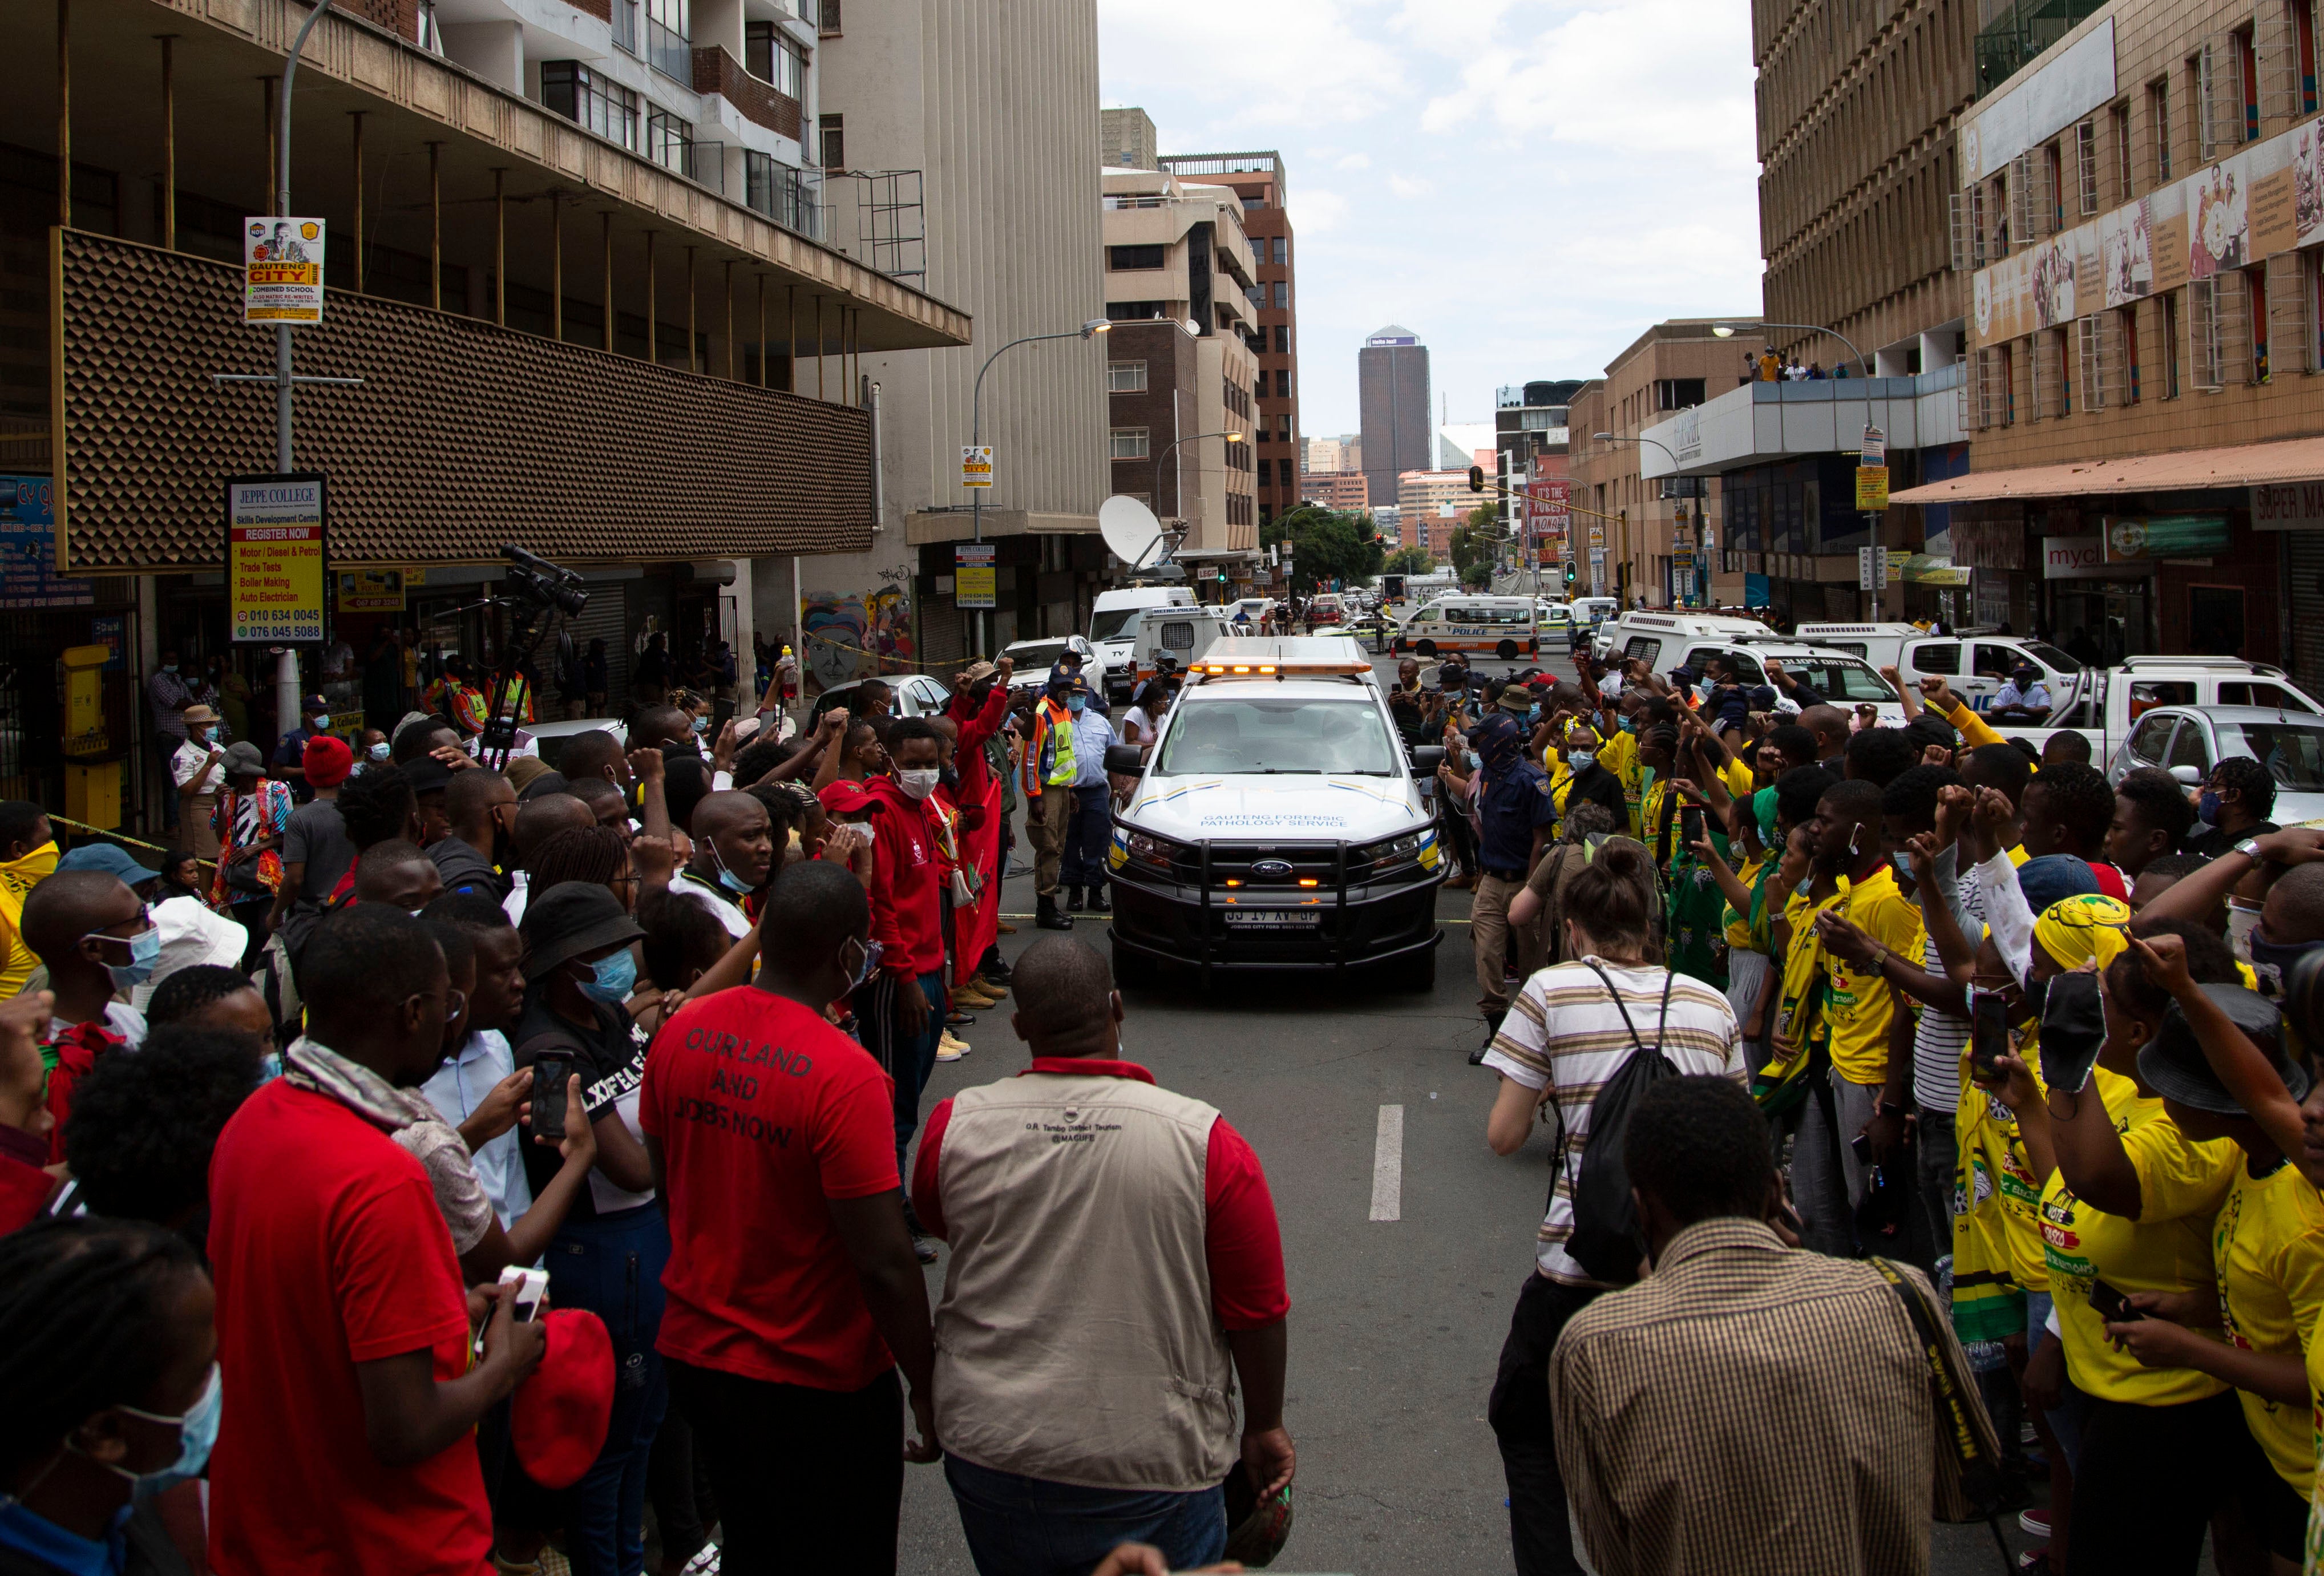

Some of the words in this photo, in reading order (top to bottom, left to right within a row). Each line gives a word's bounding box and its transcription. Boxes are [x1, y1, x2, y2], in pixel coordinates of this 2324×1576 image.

[250, 271, 306, 281] CITY
[240, 489, 268, 503] JEPPE
[269, 487, 315, 502] COLLEGE
[1537, 487, 1550, 498] IT'S
[1551, 487, 1563, 498] THE
[2258, 487, 2297, 519] SUPER
[236, 515, 254, 524] Skills
[256, 514, 297, 526] Development
[298, 514, 319, 523] Centre
[246, 528, 288, 540] REGISTER
[289, 527, 309, 539] NOW
[240, 548, 261, 557] Motor
[267, 547, 290, 557] Diesel
[292, 547, 297, 556] &
[299, 545, 320, 556] Petrol
[240, 562, 260, 572] Trade
[262, 561, 281, 572] Tests
[240, 577, 262, 587] Boiler
[264, 577, 290, 589] Making
[240, 592, 258, 603] Auto
[259, 592, 298, 602] Electrician
[250, 610, 268, 621] 010
[272, 609, 290, 621] 634
[294, 609, 320, 621] 0045
[250, 627, 269, 637] 076
[272, 627, 291, 637] 045
[294, 626, 320, 637] 5088
[337, 716, 362, 727] Cellular
[1833, 993, 1856, 1003] LECTIONS
[685, 1028, 739, 1058] OUR
[738, 1039, 813, 1077] LAND
[712, 1068, 758, 1100] AND
[674, 1096, 729, 1129] JOBS
[733, 1110, 793, 1148] NOW
[2048, 1205, 2066, 1223] VOTE
[2044, 1226, 2066, 1247] SASCO
